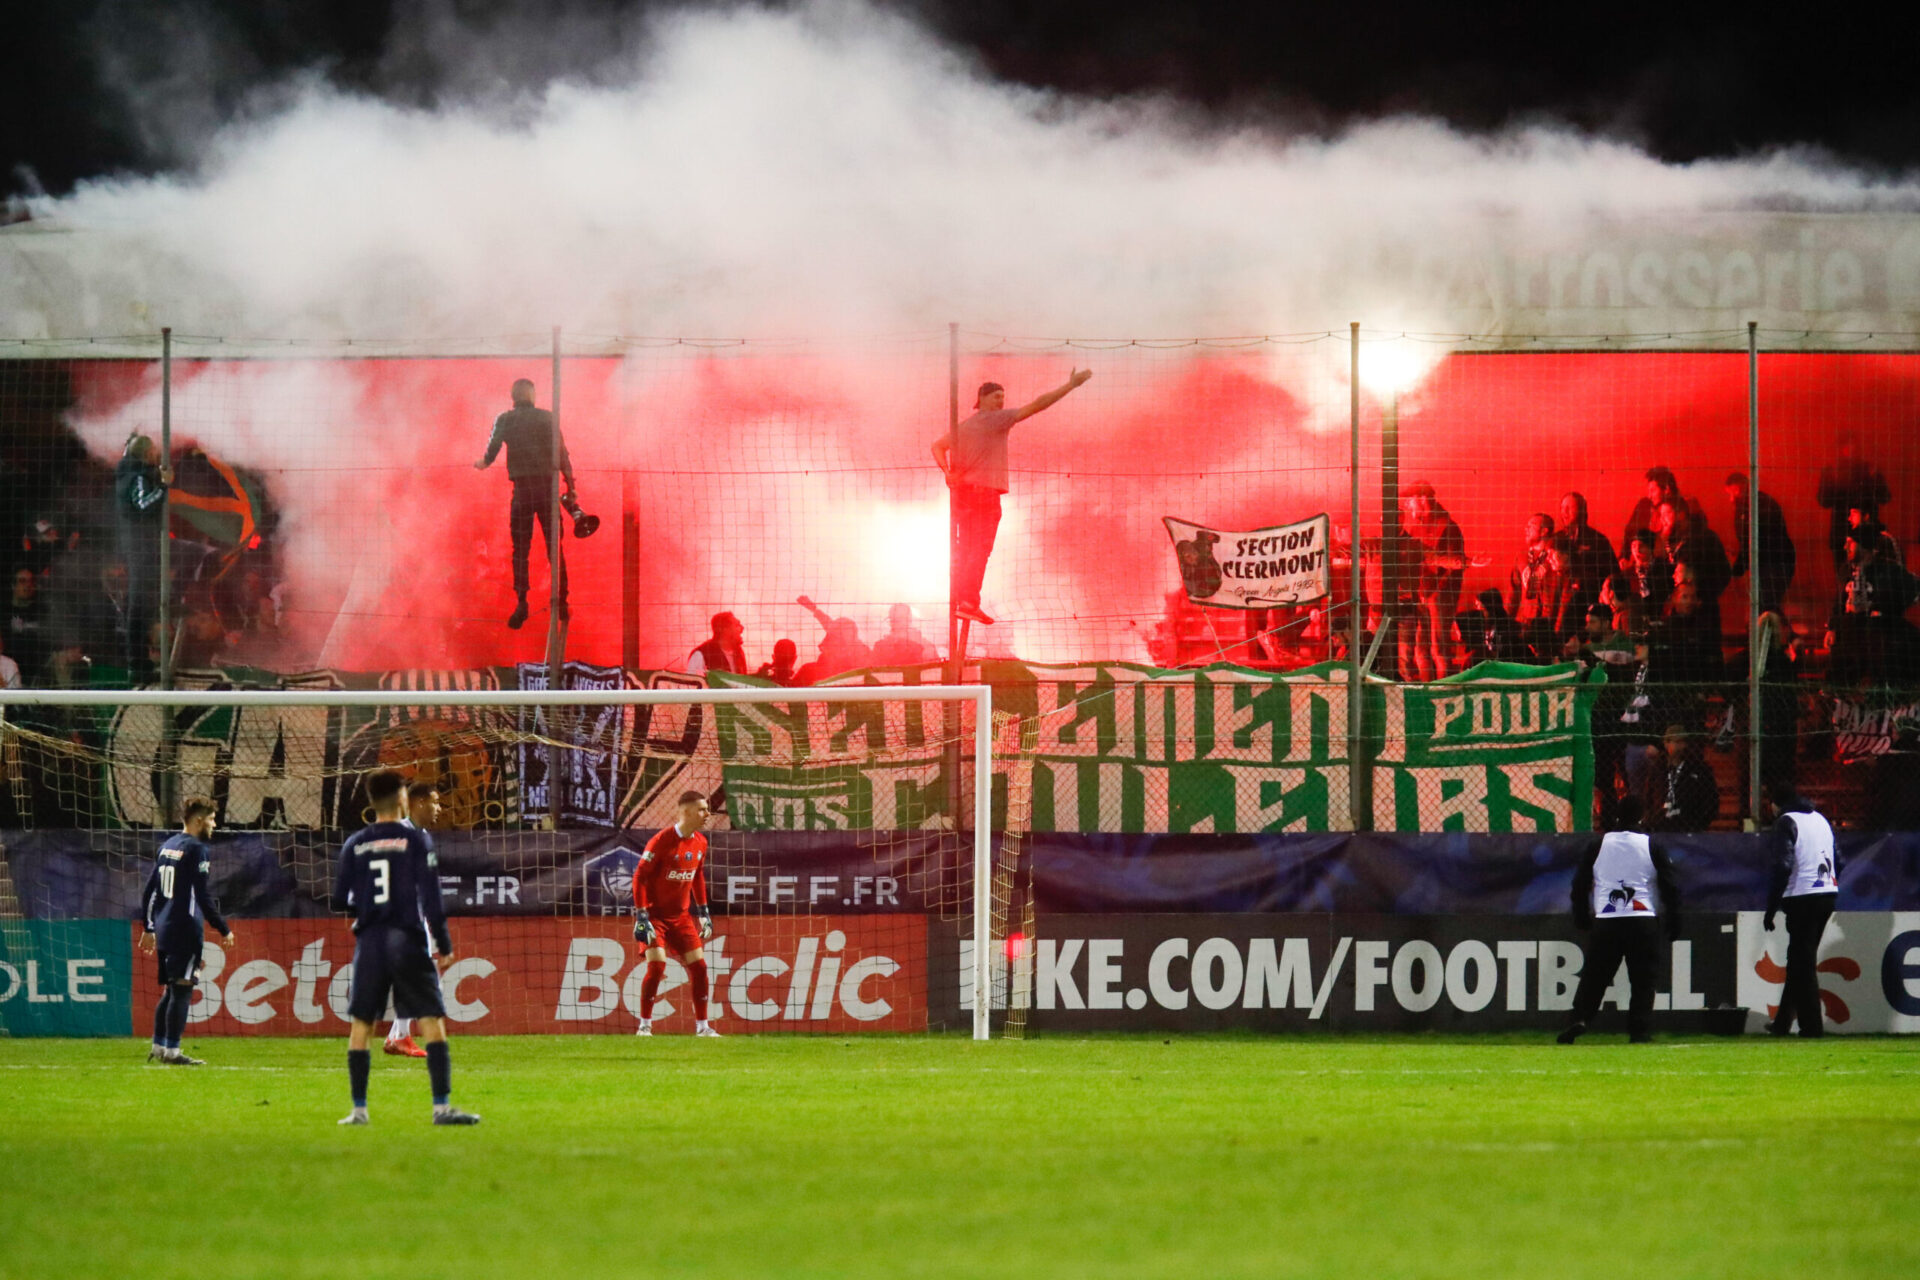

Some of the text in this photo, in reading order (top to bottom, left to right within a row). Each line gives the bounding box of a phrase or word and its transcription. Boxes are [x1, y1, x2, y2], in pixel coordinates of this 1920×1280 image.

[1236, 526, 1315, 557] SECTION
[1222, 550, 1325, 579] CLERMONT
[1431, 686, 1576, 740] POUR
[158, 865, 175, 899] 10
[369, 859, 390, 904] 3
[555, 929, 901, 1021] Betclic
